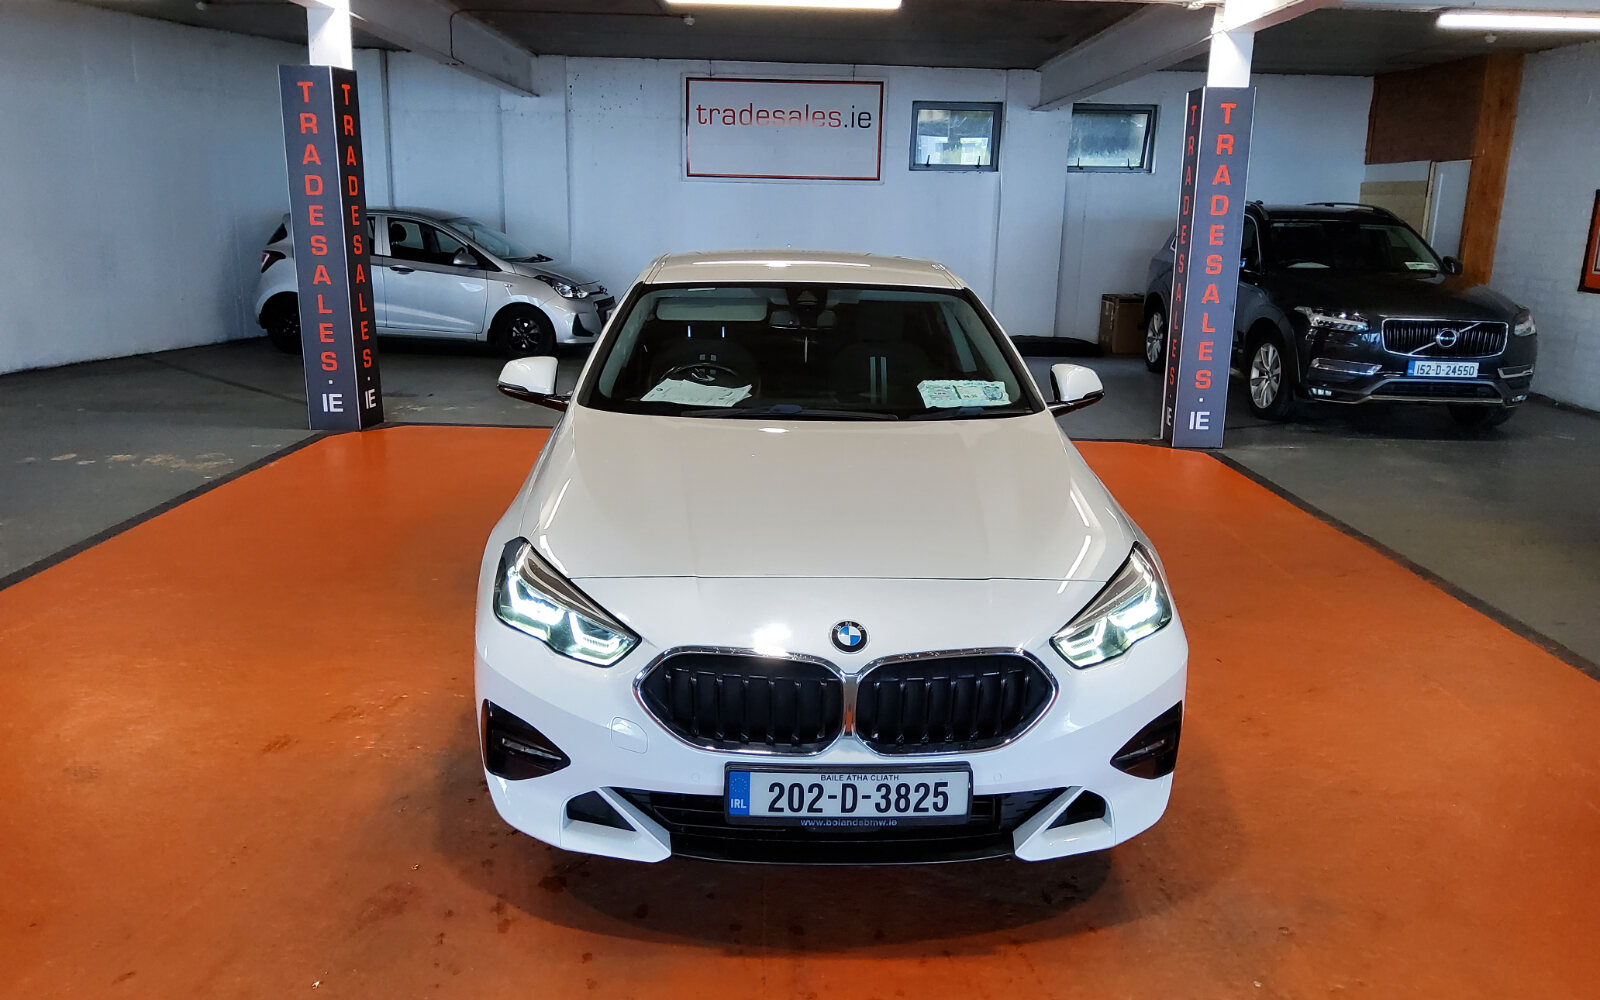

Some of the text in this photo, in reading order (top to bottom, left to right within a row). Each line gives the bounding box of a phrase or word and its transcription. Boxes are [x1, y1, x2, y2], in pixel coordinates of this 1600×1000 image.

[695, 103, 872, 129] tradesales.ie
[1416, 364, 1475, 376] 152-D-24550
[820, 774, 844, 782] BAILE
[870, 774, 900, 782] CLIATH
[730, 798, 747, 809] IRL
[767, 782, 949, 813] 202-D-3825
